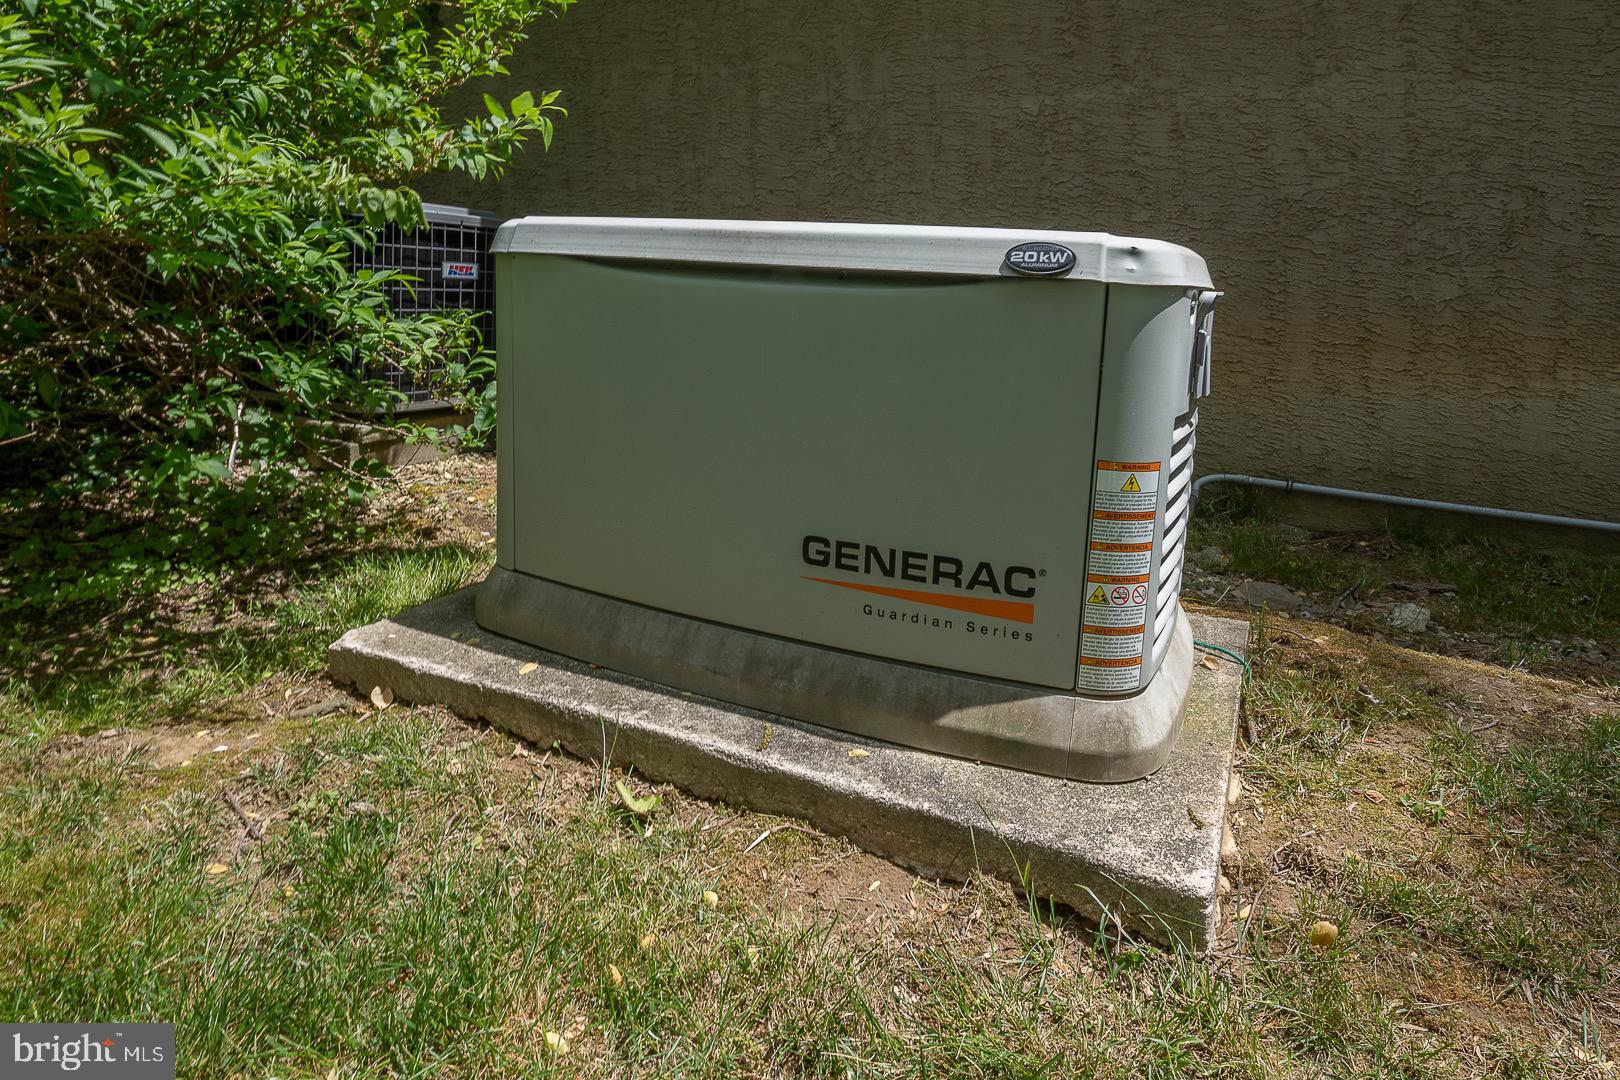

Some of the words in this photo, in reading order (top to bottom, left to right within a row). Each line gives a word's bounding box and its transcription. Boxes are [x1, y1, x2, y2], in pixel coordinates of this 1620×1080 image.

[802, 535, 1036, 598] GENERAC
[863, 604, 953, 629] Guardian
[966, 621, 1033, 642] Series
